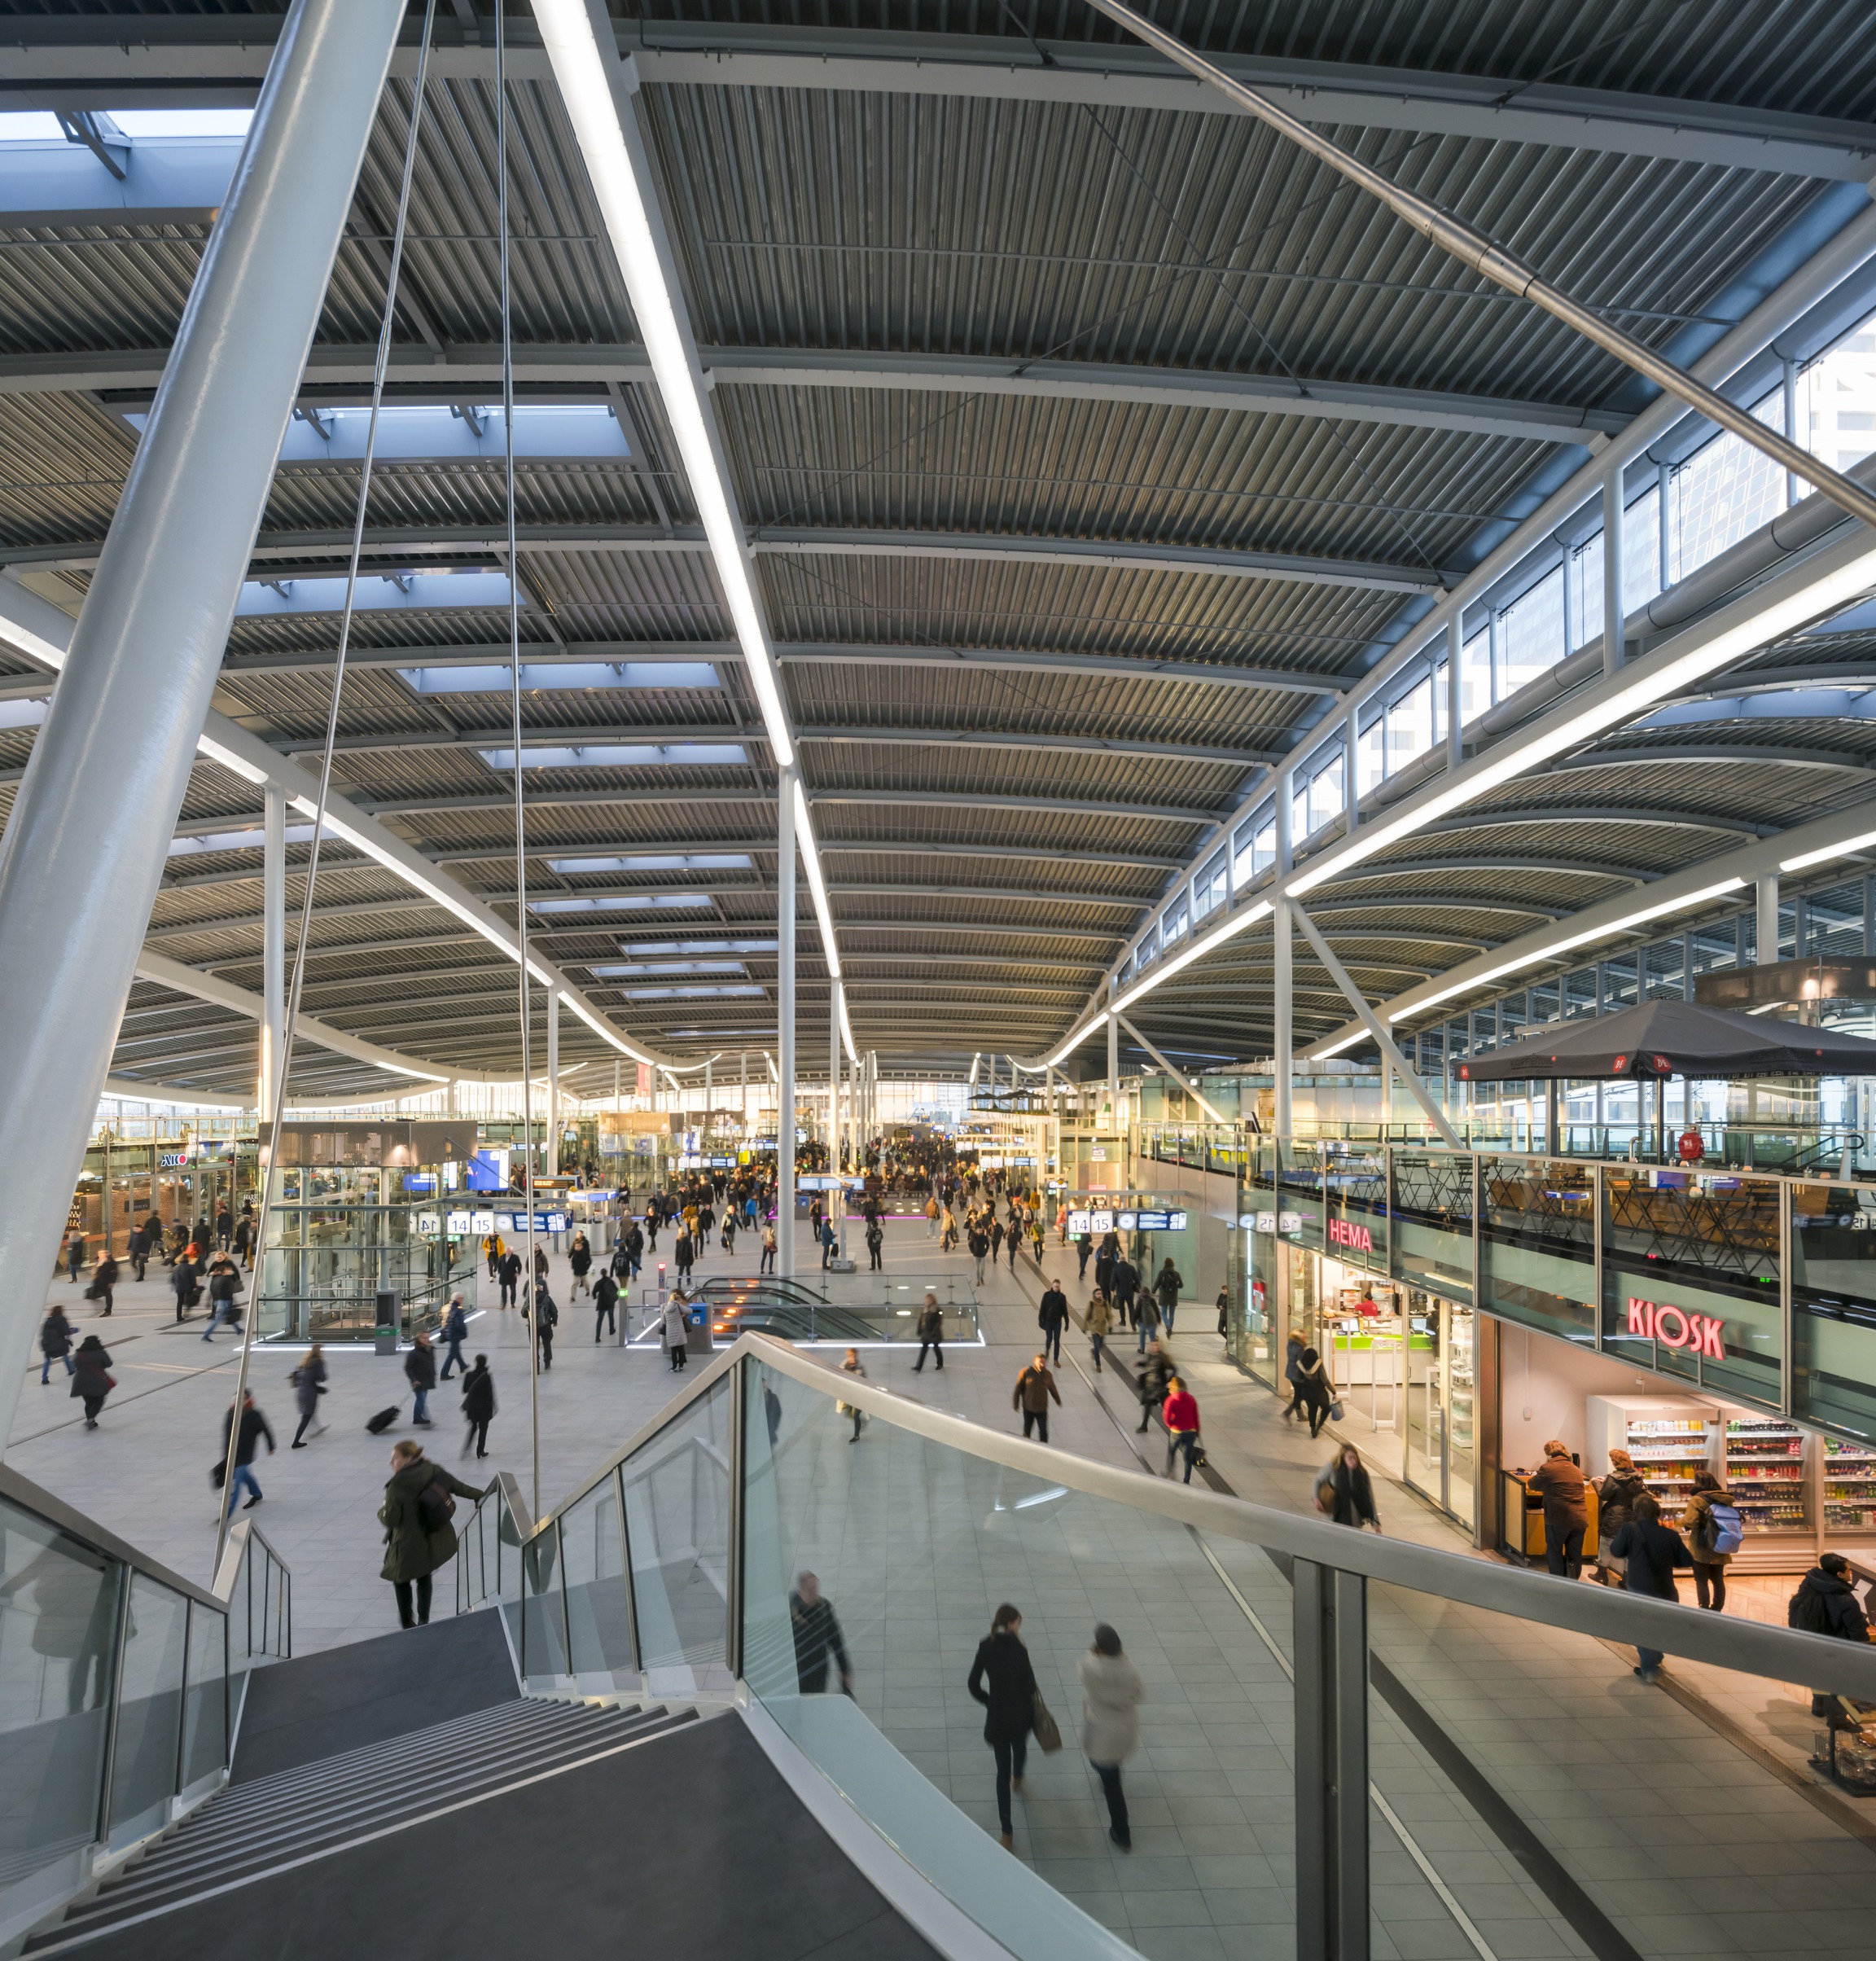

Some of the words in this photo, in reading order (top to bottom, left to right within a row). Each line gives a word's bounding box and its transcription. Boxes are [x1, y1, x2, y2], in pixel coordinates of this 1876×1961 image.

[161, 1154, 187, 1166] AKO
[452, 1220, 467, 1231] 14
[476, 1220, 490, 1231] 15
[1072, 1219, 1088, 1231] 14
[1094, 1218, 1109, 1231] 15
[1330, 1218, 1373, 1252] HEMA
[1628, 1296, 1725, 1361] KIOSK
